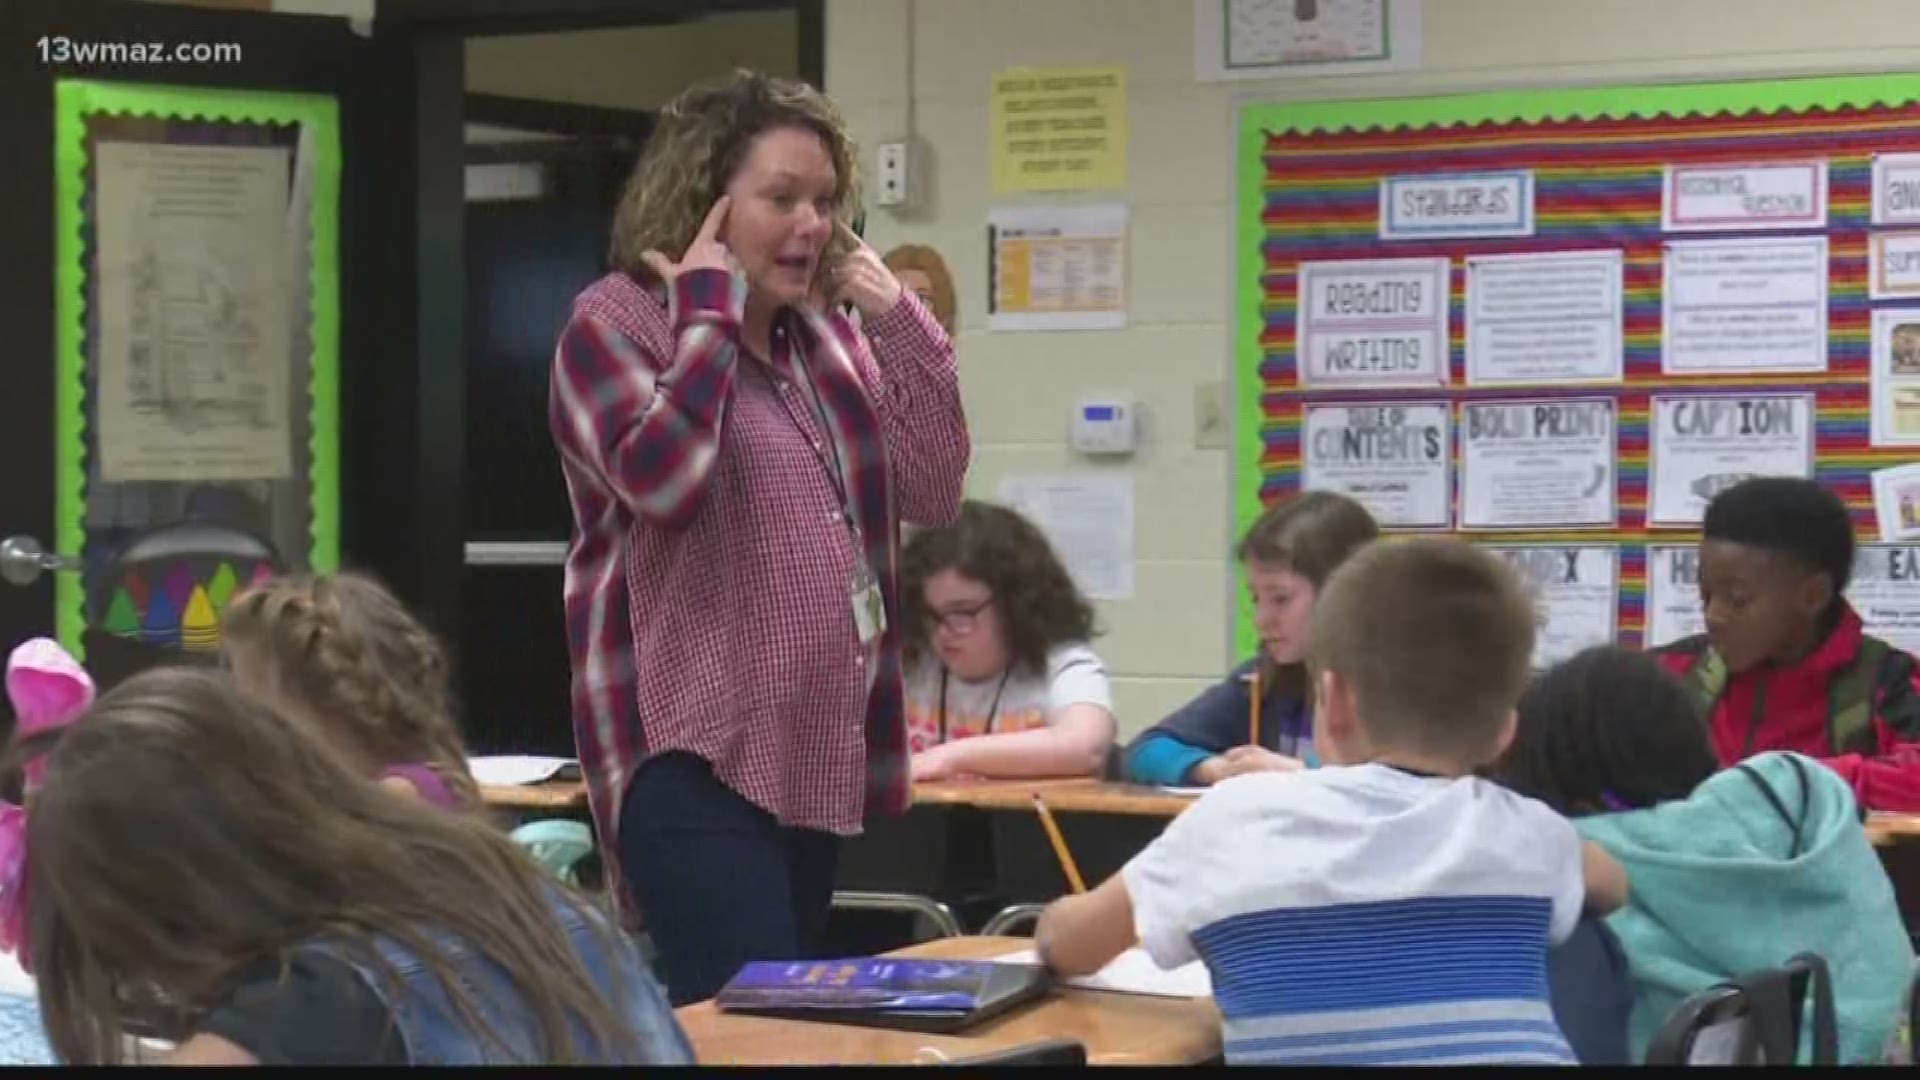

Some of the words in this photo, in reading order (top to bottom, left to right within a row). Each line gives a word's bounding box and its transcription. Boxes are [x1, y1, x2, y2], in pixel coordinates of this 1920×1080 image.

[1535, 404, 1607, 438] PRINT
[1672, 398, 1793, 435] CAPTION
[1313, 426, 1441, 461] CONTENTS
